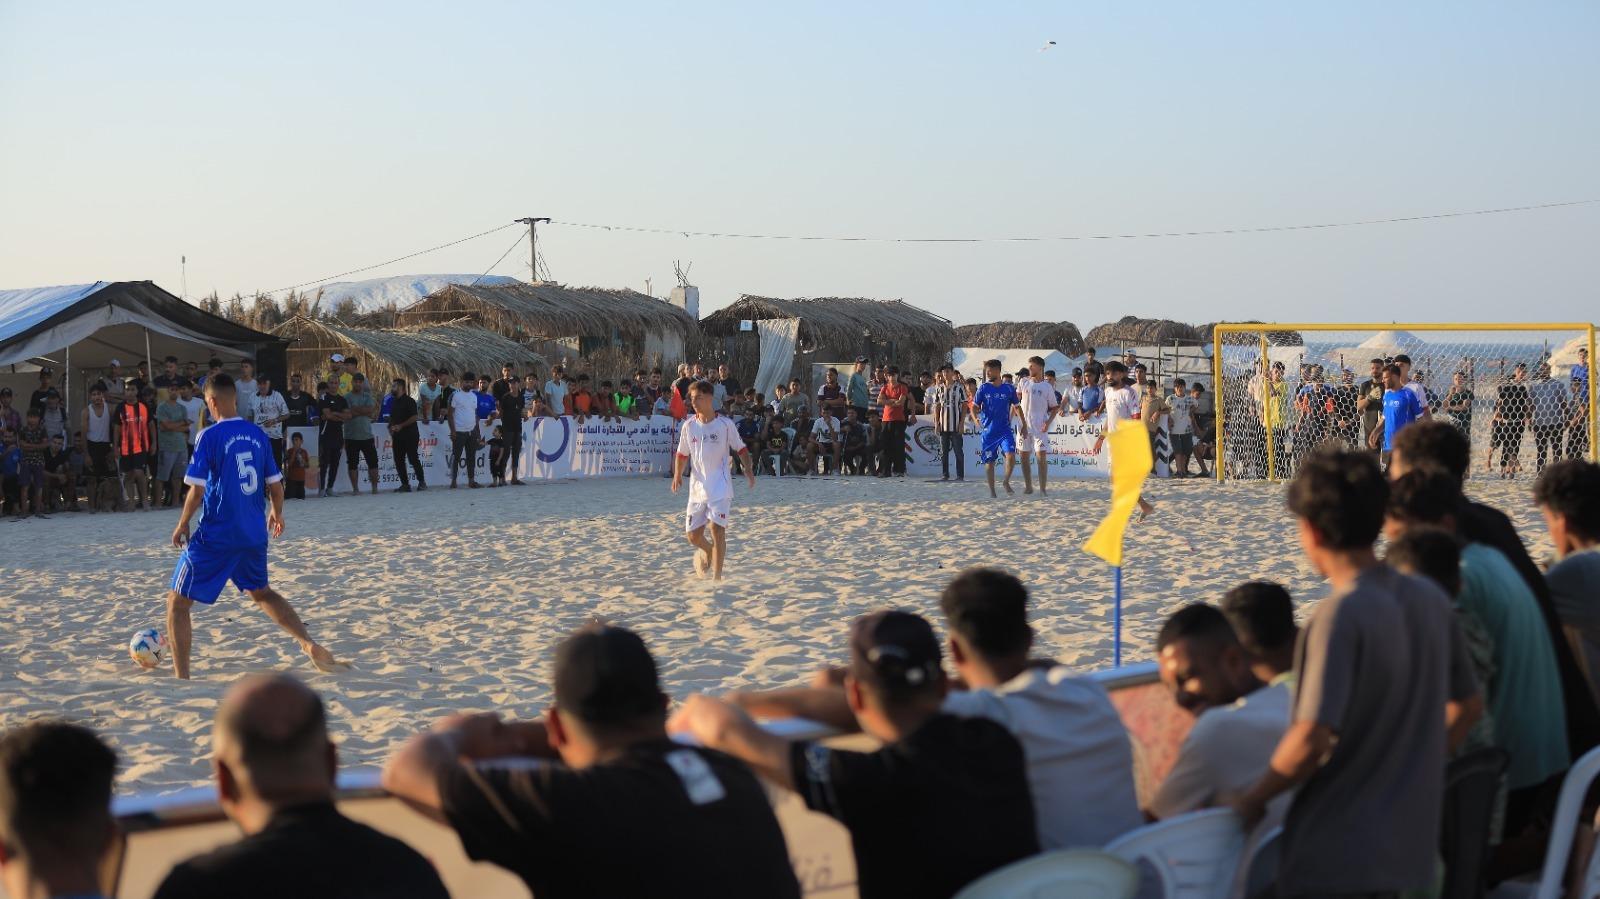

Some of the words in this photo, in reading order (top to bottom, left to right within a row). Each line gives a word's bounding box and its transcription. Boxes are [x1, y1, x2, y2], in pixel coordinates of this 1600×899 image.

[1047, 424, 1068, 435] الق
[1070, 424, 1084, 438] كرة
[235, 452, 257, 496] 5
